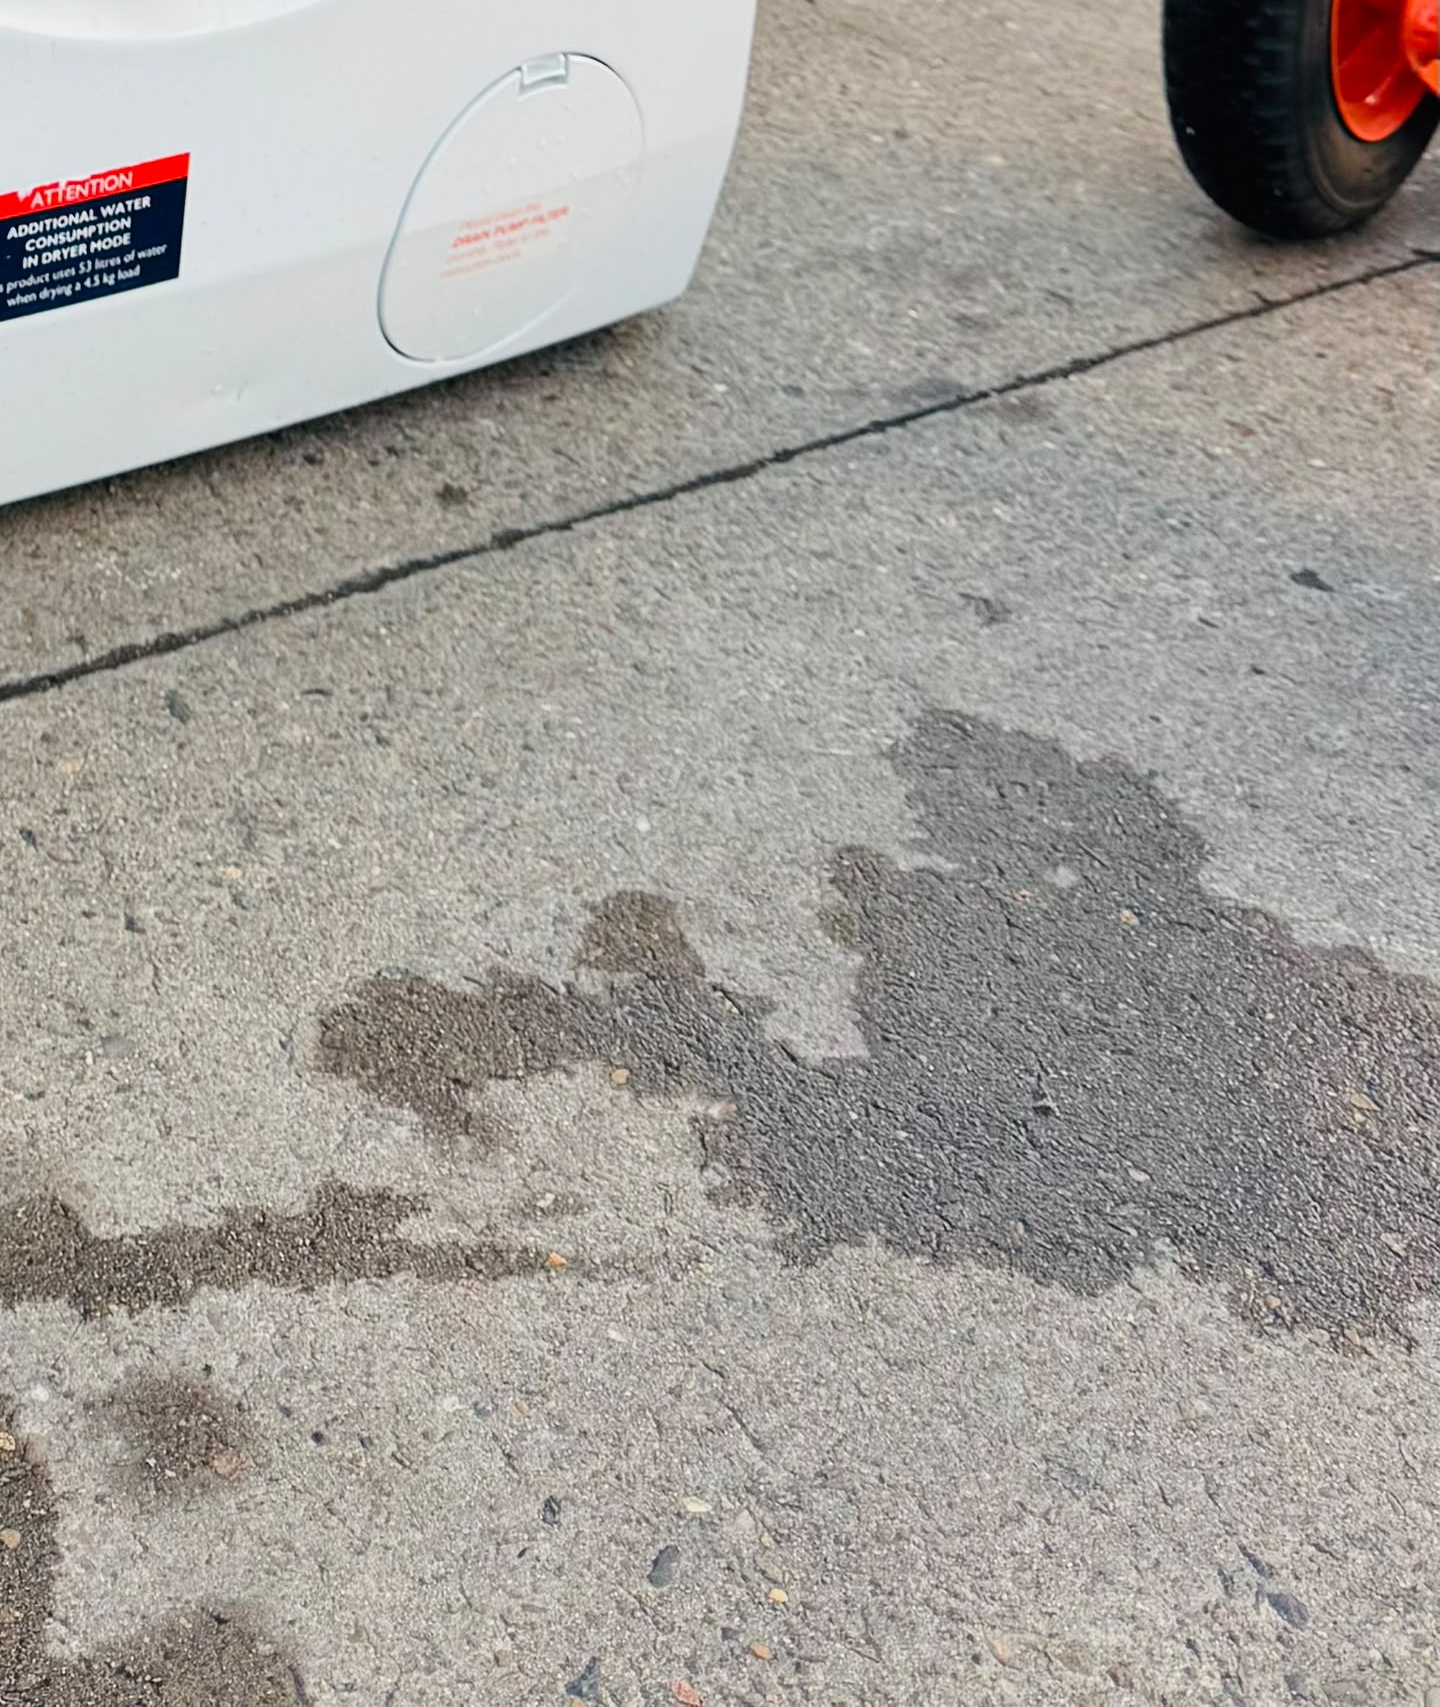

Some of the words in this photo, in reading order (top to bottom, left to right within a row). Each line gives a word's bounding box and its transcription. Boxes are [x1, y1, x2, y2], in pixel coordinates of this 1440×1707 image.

[30, 171, 134, 209] ATTENTION
[7, 209, 97, 240] ADDITIONAL
[100, 196, 151, 219] WATER
[25, 217, 132, 252] CONSUMPTION
[6, 272, 50, 294] product
[52, 268, 76, 281] uses
[79, 261, 92, 274] 53
[94, 254, 121, 271] litres
[123, 250, 136, 263] of
[137, 244, 168, 260] water
[22, 256, 38, 269] IN
[41, 245, 88, 265] DRYER
[90, 233, 131, 254] MODE
[6, 292, 37, 307] when
[39, 284, 73, 301] drying
[74, 281, 82, 291] a
[84, 275, 101, 288] 4.5
[102, 271, 116, 285] kg
[117, 264, 141, 279] load
